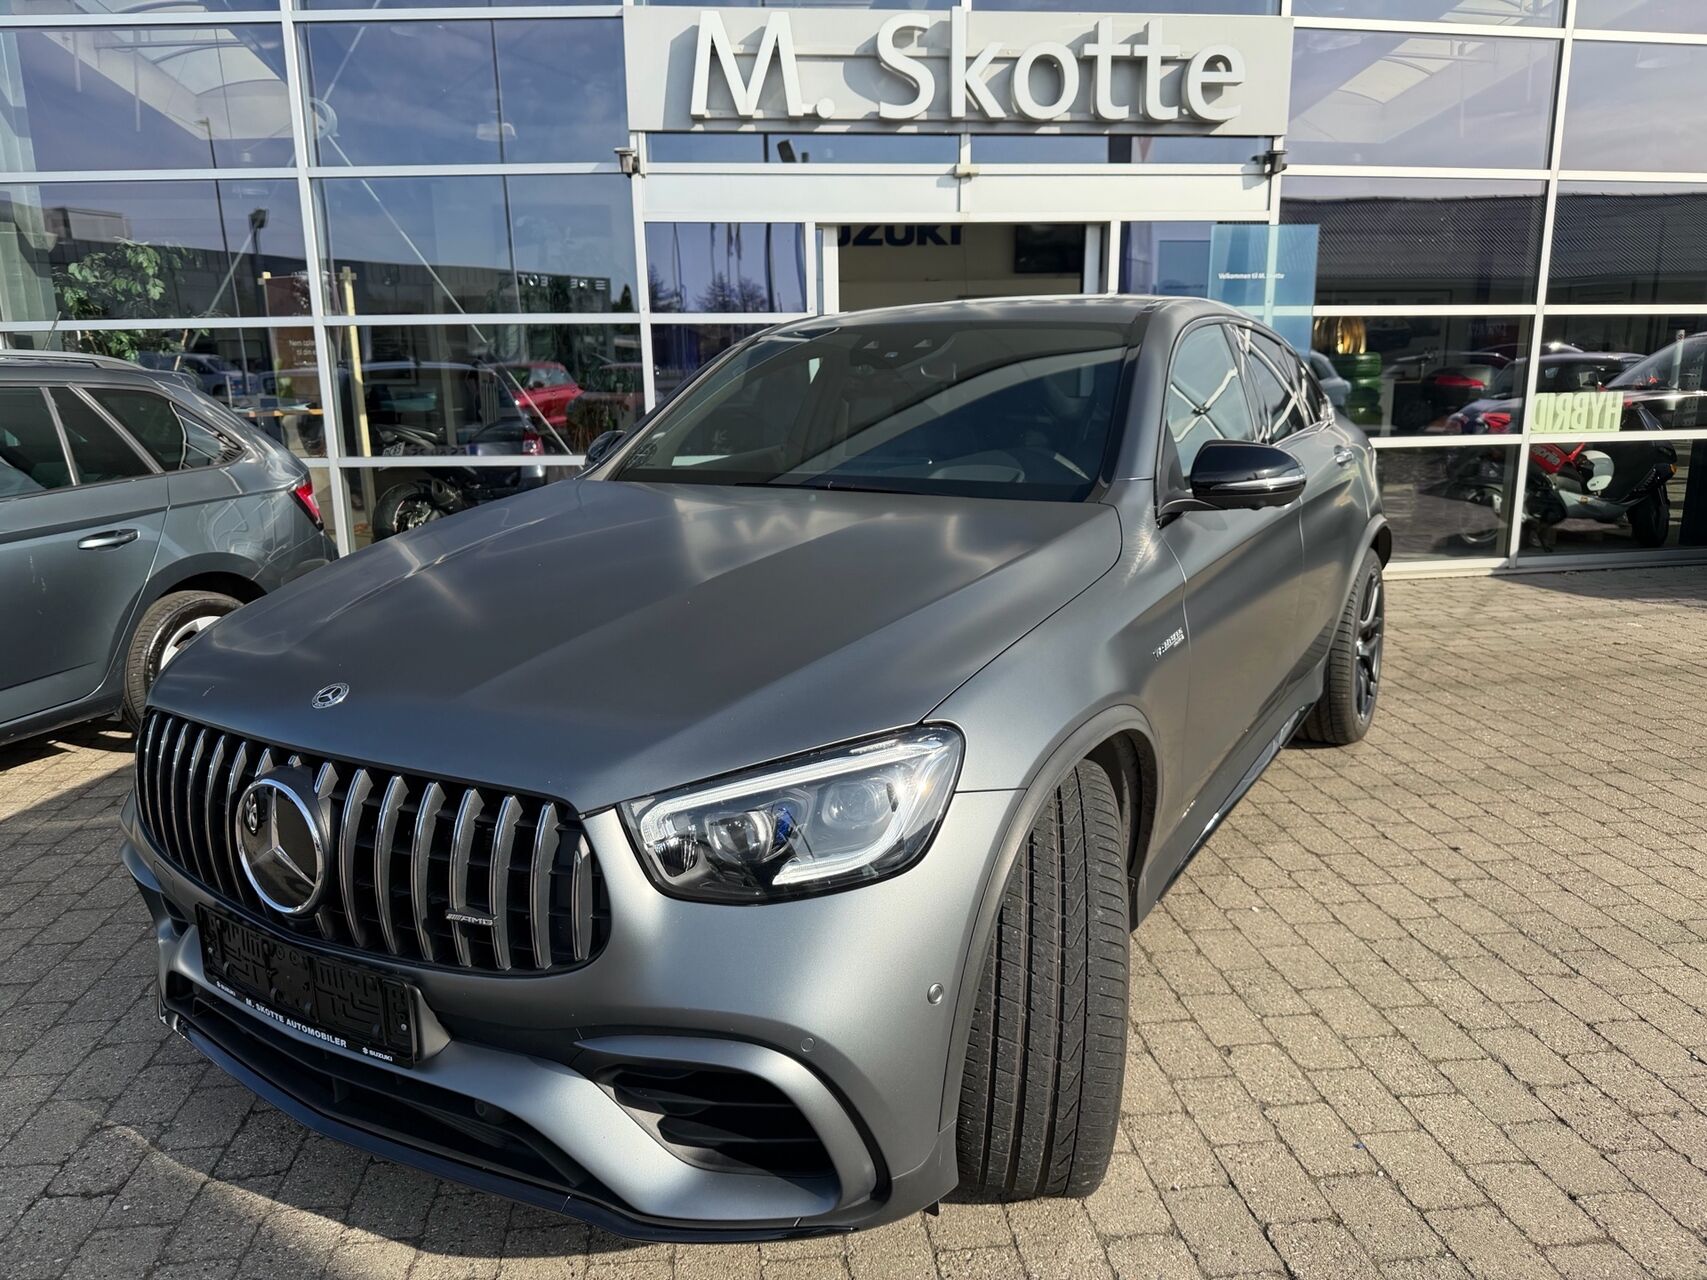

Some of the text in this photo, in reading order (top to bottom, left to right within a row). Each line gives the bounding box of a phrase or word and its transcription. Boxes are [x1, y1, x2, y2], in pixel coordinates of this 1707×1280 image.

[690, 5, 1247, 122] M. Skotte
[1217, 271, 1251, 280] Velkommen
[460, 915, 493, 926] AMG
[245, 997, 347, 1049] M. SKOTTE AUTOMOBILER
[369, 1049, 393, 1063] SUZUKI
